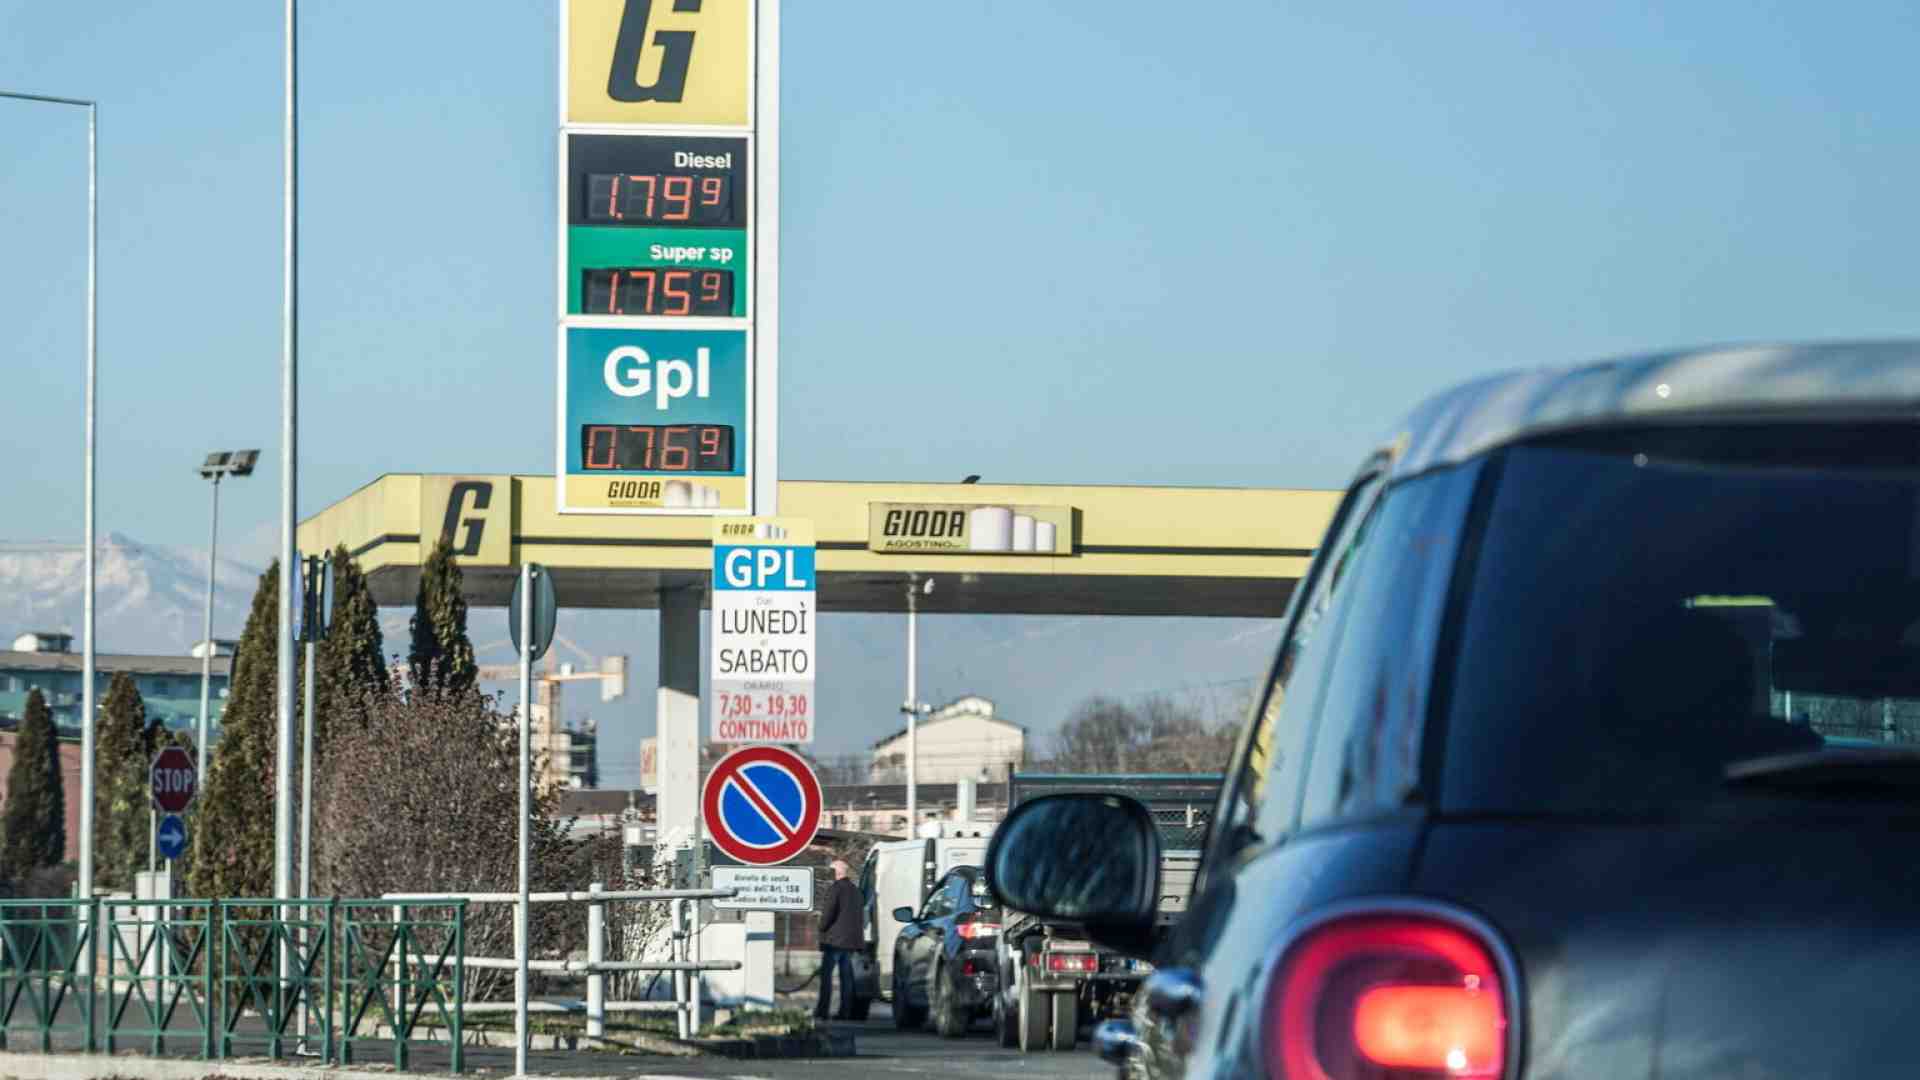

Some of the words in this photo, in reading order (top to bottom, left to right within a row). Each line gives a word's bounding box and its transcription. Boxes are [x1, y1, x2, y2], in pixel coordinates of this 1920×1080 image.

[607, 0, 702, 103] G
[674, 152, 731, 168] Diesel
[650, 244, 705, 264] Super
[710, 248, 733, 264] sp
[604, 345, 710, 410] Gpl
[608, 481, 661, 498] GIODA
[440, 481, 493, 556] G
[884, 510, 965, 537] GIODA
[725, 548, 807, 588] GPL
[721, 601, 808, 634] LUNEDÌ
[719, 649, 808, 673] SABATO
[720, 694, 752, 718] 7,30
[767, 694, 807, 719] 19,30
[719, 720, 808, 740] CONTINUATO
[154, 768, 193, 793] STOP
